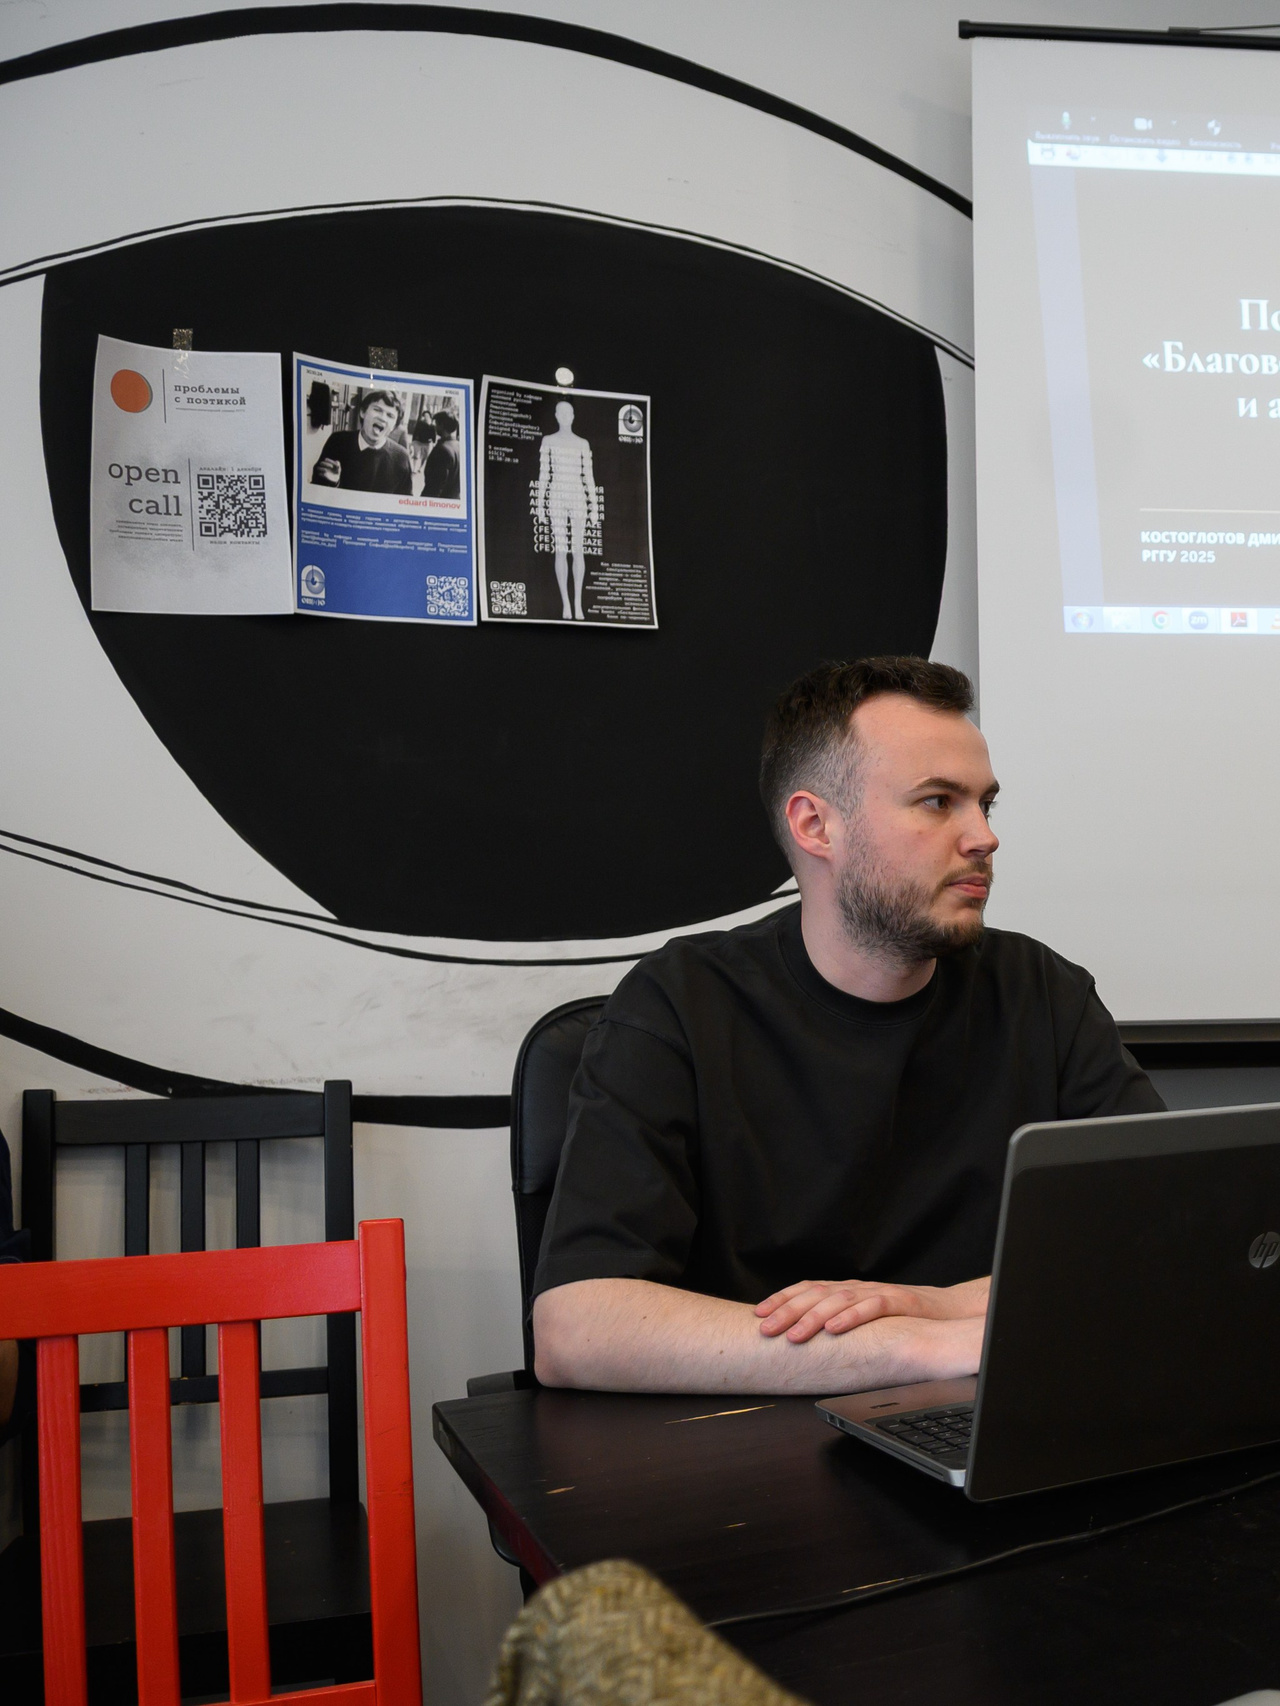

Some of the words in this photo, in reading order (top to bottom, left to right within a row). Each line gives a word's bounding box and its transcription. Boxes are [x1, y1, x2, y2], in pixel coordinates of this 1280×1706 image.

[174, 384, 240, 395] проблемы
[186, 396, 246, 406] поэтикой
[1237, 396, 1259, 418] и
[108, 462, 181, 486] open
[128, 495, 183, 516] call
[398, 498, 427, 507] eduard
[429, 500, 461, 510] limonov
[1140, 530, 1246, 546] КОСТОГЛОТОВ
[1141, 550, 1177, 563] РГГУ
[1180, 550, 1216, 564] 2025
[1251, 1232, 1280, 1268] hp
